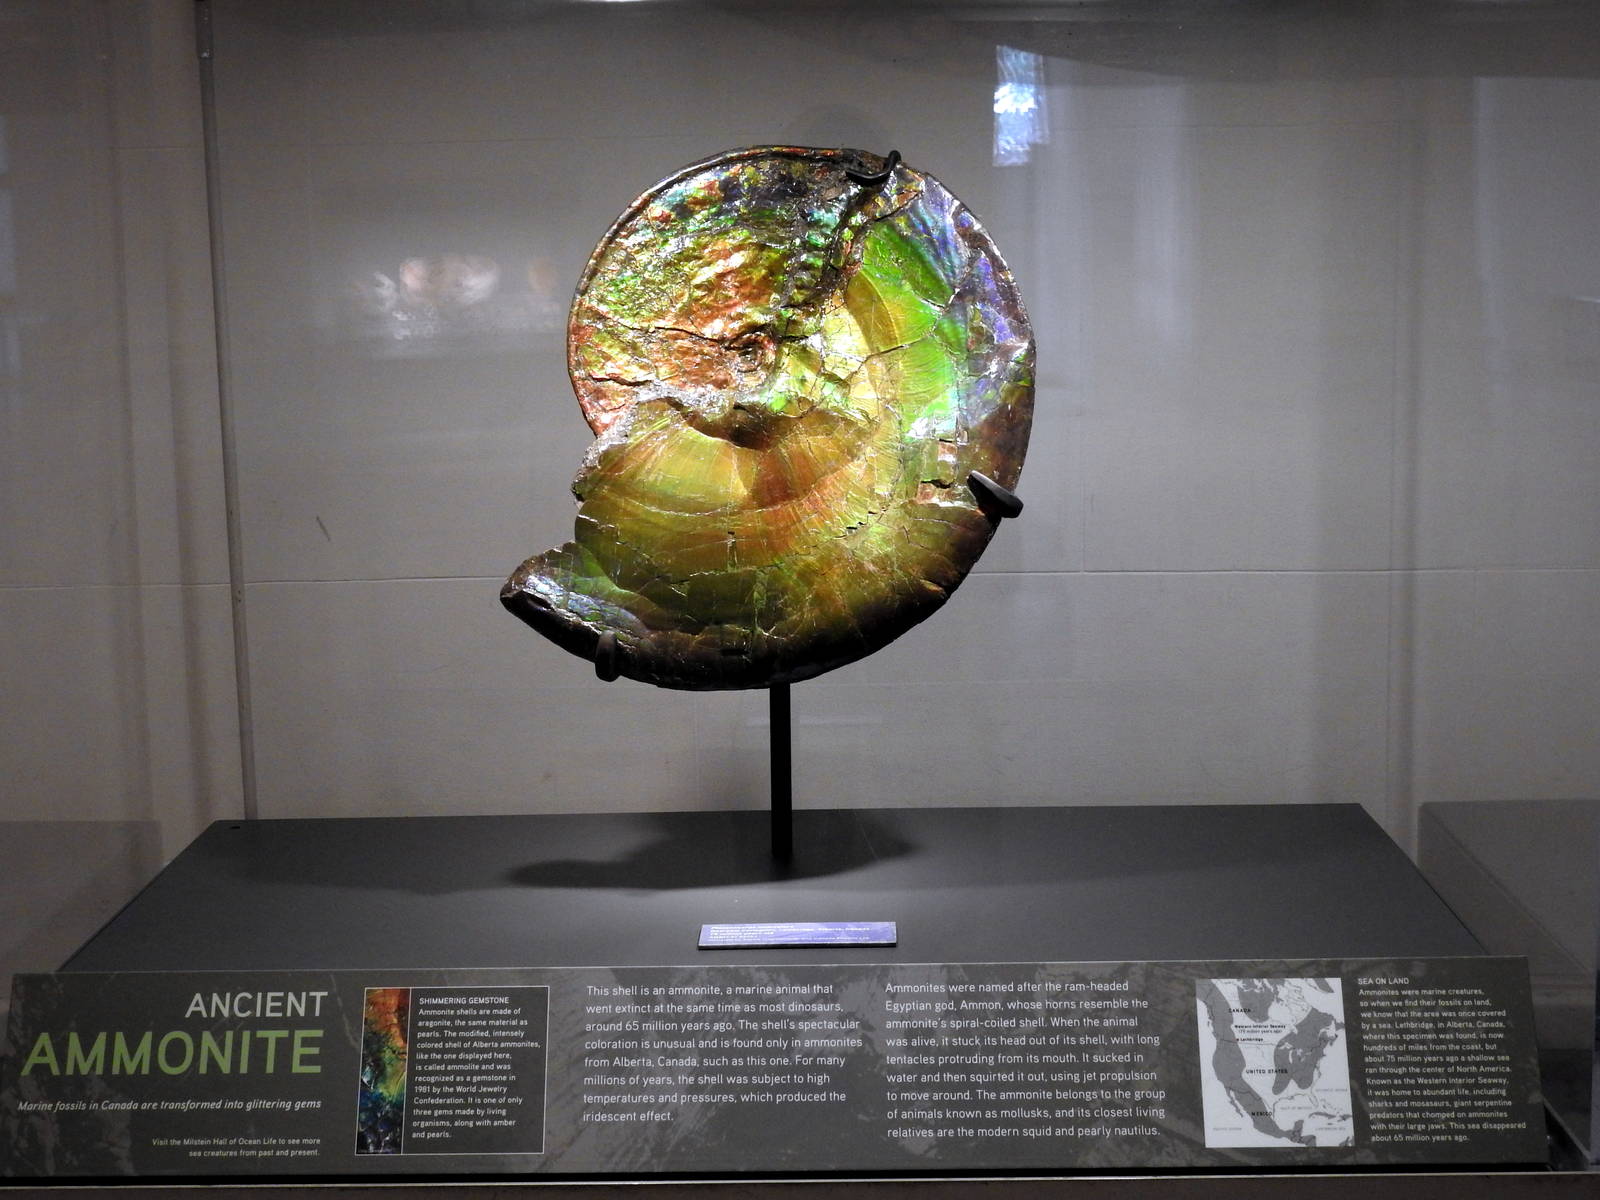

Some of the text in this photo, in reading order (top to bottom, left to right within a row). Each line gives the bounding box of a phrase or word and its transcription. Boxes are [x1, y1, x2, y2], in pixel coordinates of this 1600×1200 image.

[587, 983, 832, 997] This shell is an ammonite, a marine animal that
[885, 980, 1128, 992] Ammonites were named after the ram-headed
[185, 992, 328, 1018] ANCIENT
[586, 1001, 842, 1013] went extinct at the same time as most dinosaurs,
[885, 998, 1148, 1013] Egyptian god, Ammon, whose horns resemble the
[585, 1018, 858, 1033] around 65 million years ago. The shell's spectacular
[886, 1016, 1137, 1030] ammonite's spiral-coiled shell. When the animal
[1361, 1022, 1369, 1030] by
[492, 1030, 524, 1038] intensely
[886, 1034, 1159, 1048] was alive, it stuck its head out of its shell, with long
[20, 1029, 324, 1076] AMMONITE
[458, 1052, 492, 1060] displayed
[18, 1101, 52, 1109] Marine
[54, 1101, 86, 1110] fossils
[160, 1100, 222, 1110] transformed
[246, 1100, 291, 1110] glittering
[583, 1110, 672, 1121] iridescent effect.
[183, 1137, 211, 1145] Milstein
[213, 1137, 227, 1145] Hall
[229, 1137, 236, 1145] of
[238, 1137, 261, 1145] Ocean
[263, 1137, 276, 1145] Life
[278, 1137, 285, 1145] to
[203, 1149, 237, 1157] creatures
[239, 1149, 256, 1157] from
[258, 1149, 273, 1159] past
